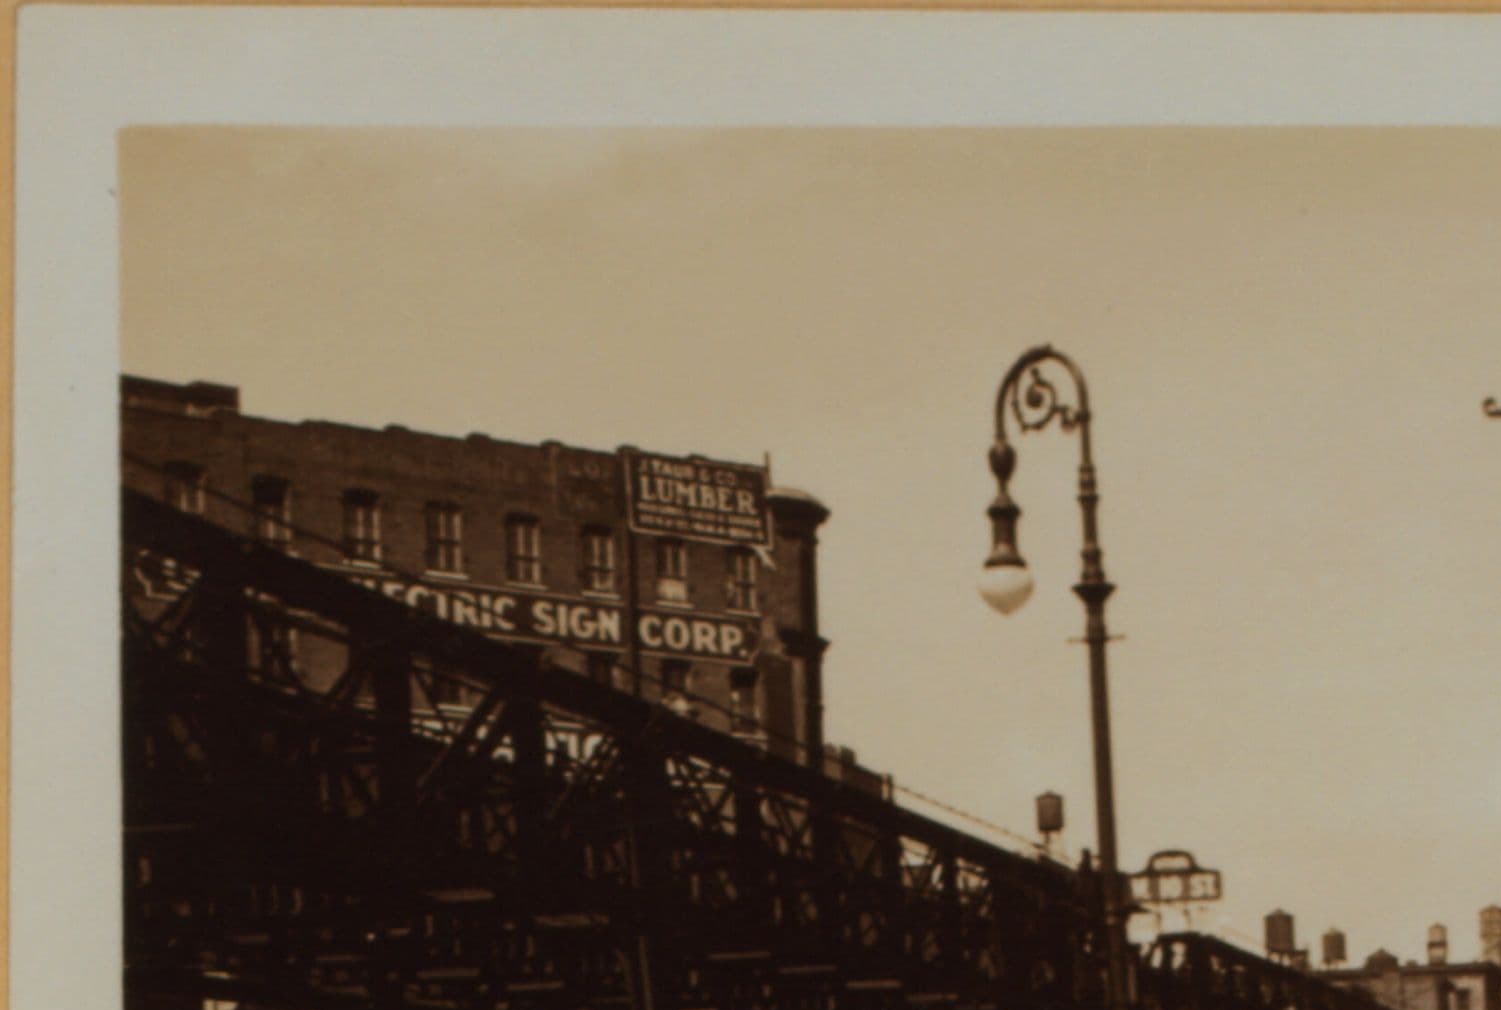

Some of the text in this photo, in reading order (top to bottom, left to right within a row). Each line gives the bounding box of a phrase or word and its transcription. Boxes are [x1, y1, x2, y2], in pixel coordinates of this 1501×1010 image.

[639, 475, 758, 515] LUMBER
[530, 599, 623, 644] SIGN
[636, 614, 750, 659] CORP.
